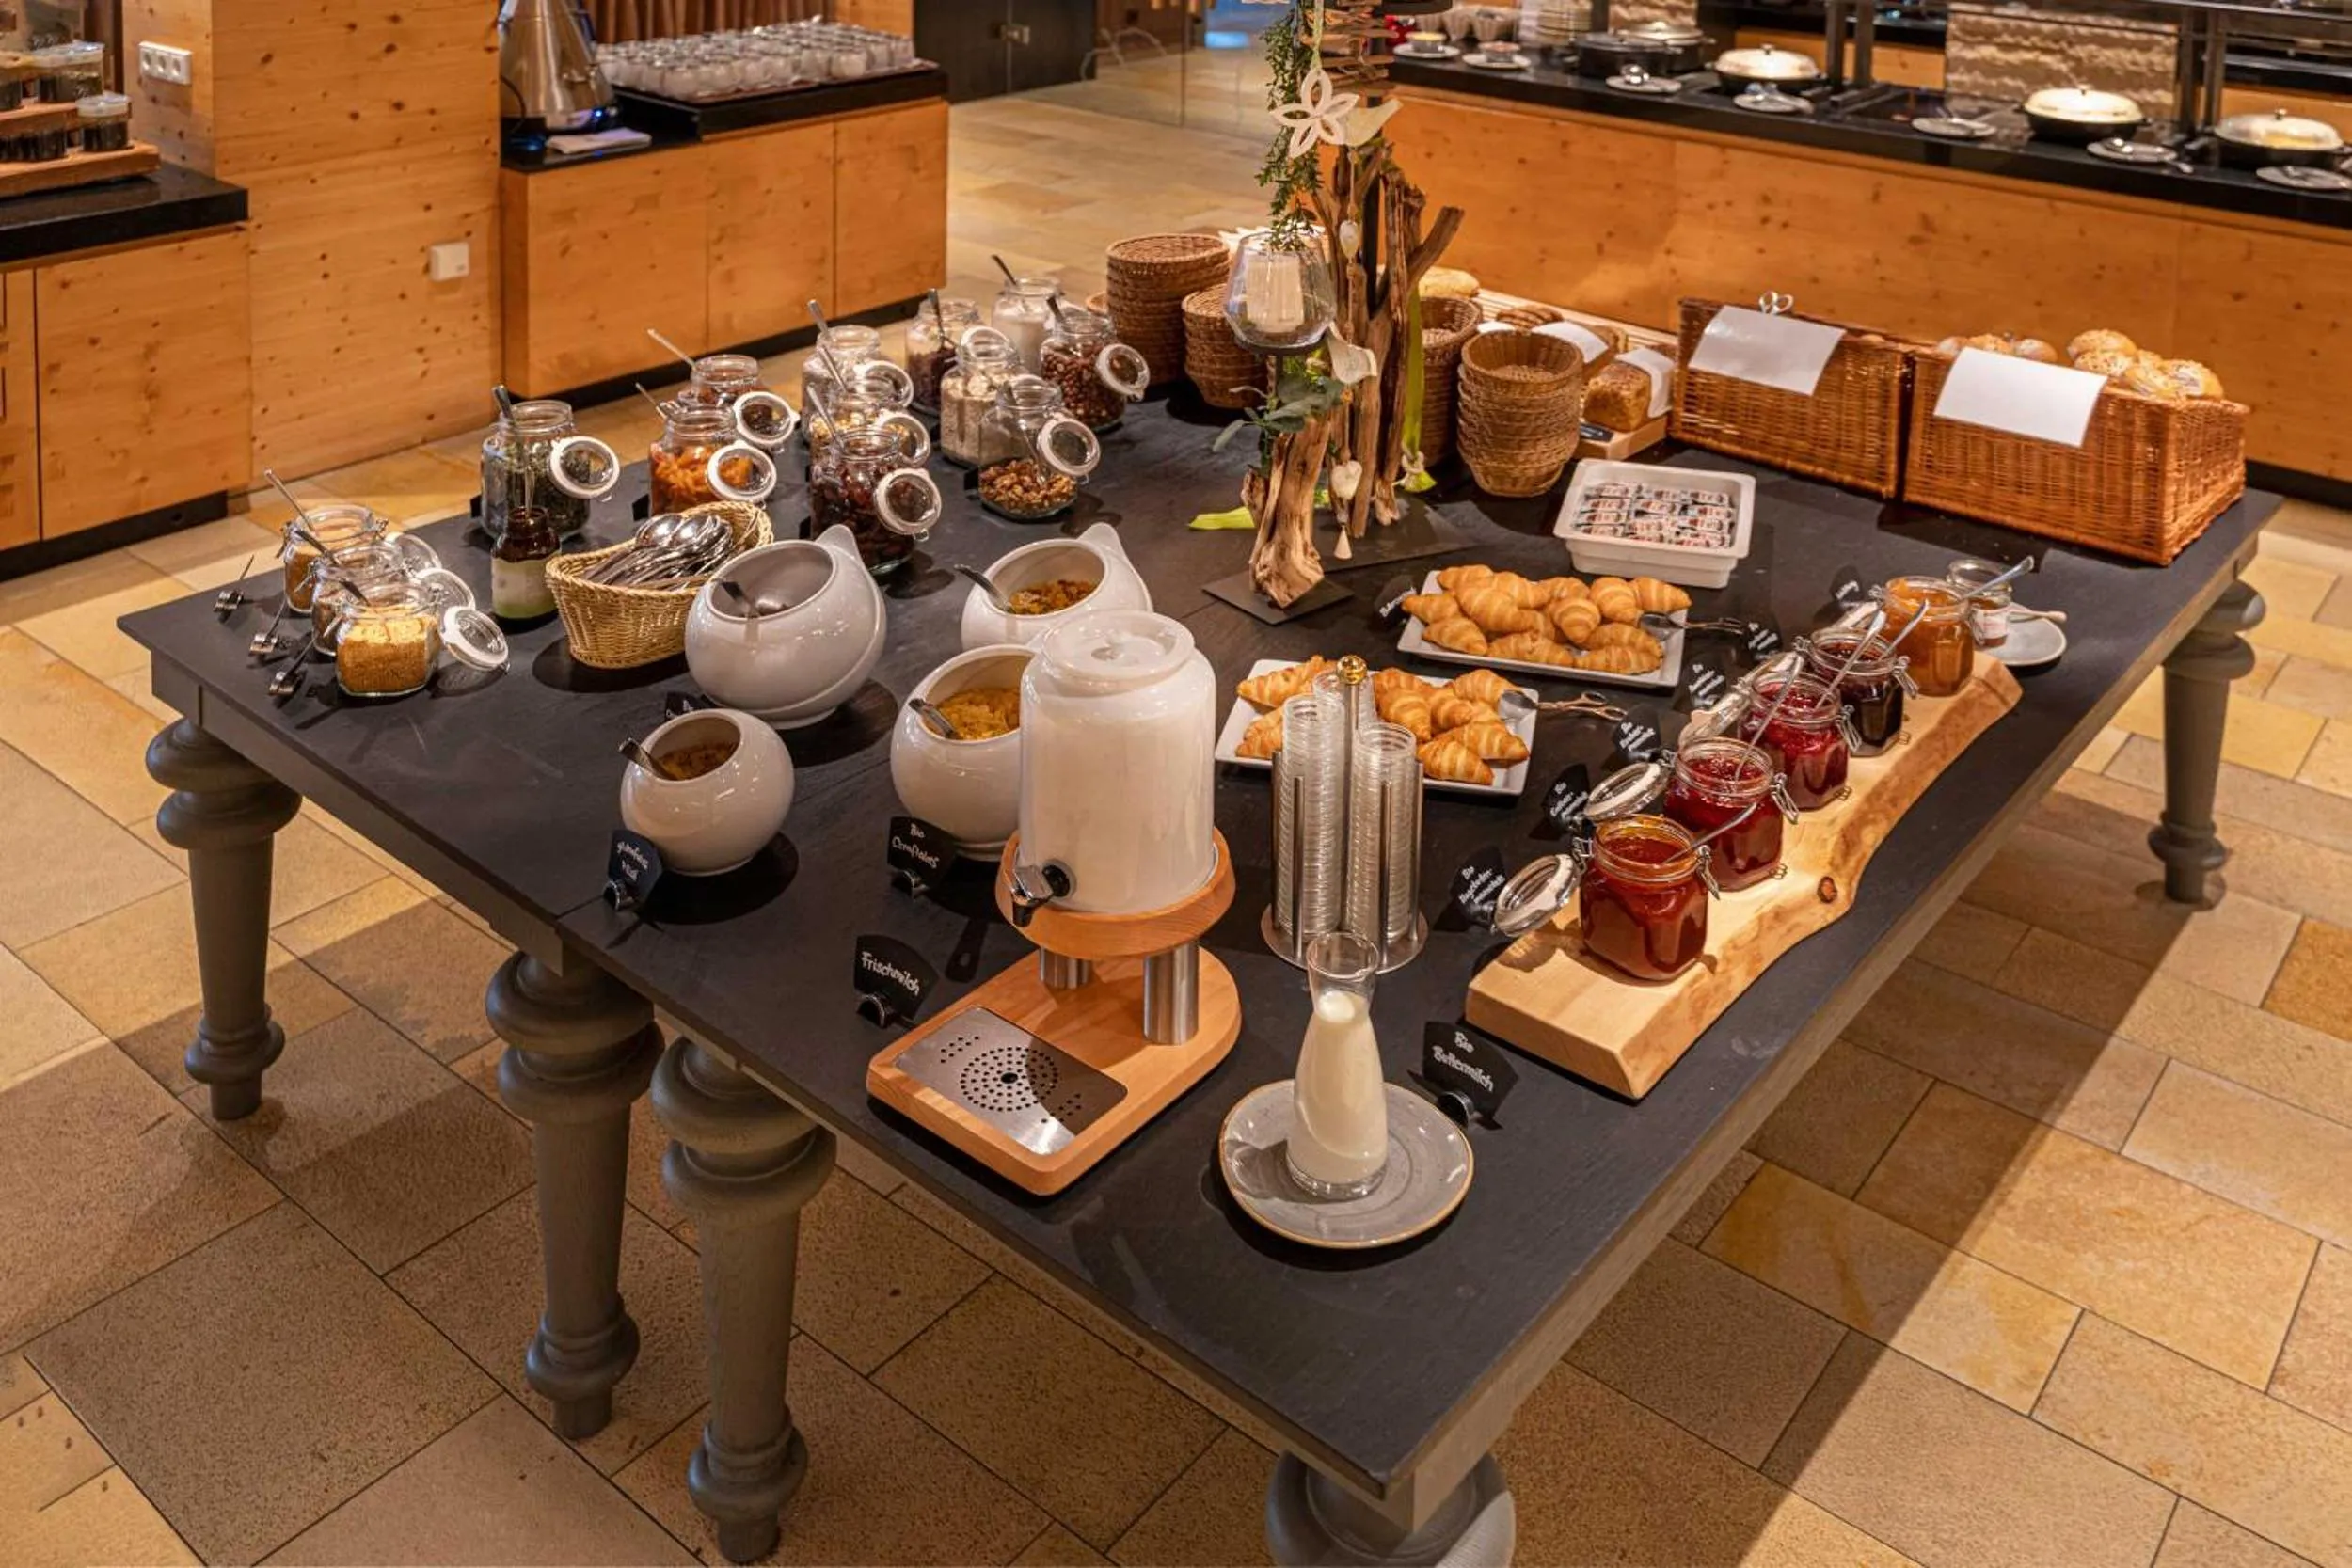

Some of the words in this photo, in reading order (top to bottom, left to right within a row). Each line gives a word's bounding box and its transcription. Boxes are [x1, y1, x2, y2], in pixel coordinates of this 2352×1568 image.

[910, 822, 925, 838] Bio
[861, 951, 920, 996] Frischmilch
[1454, 1030, 1475, 1053] Bio
[1432, 1045, 1494, 1092] Buttermilch
